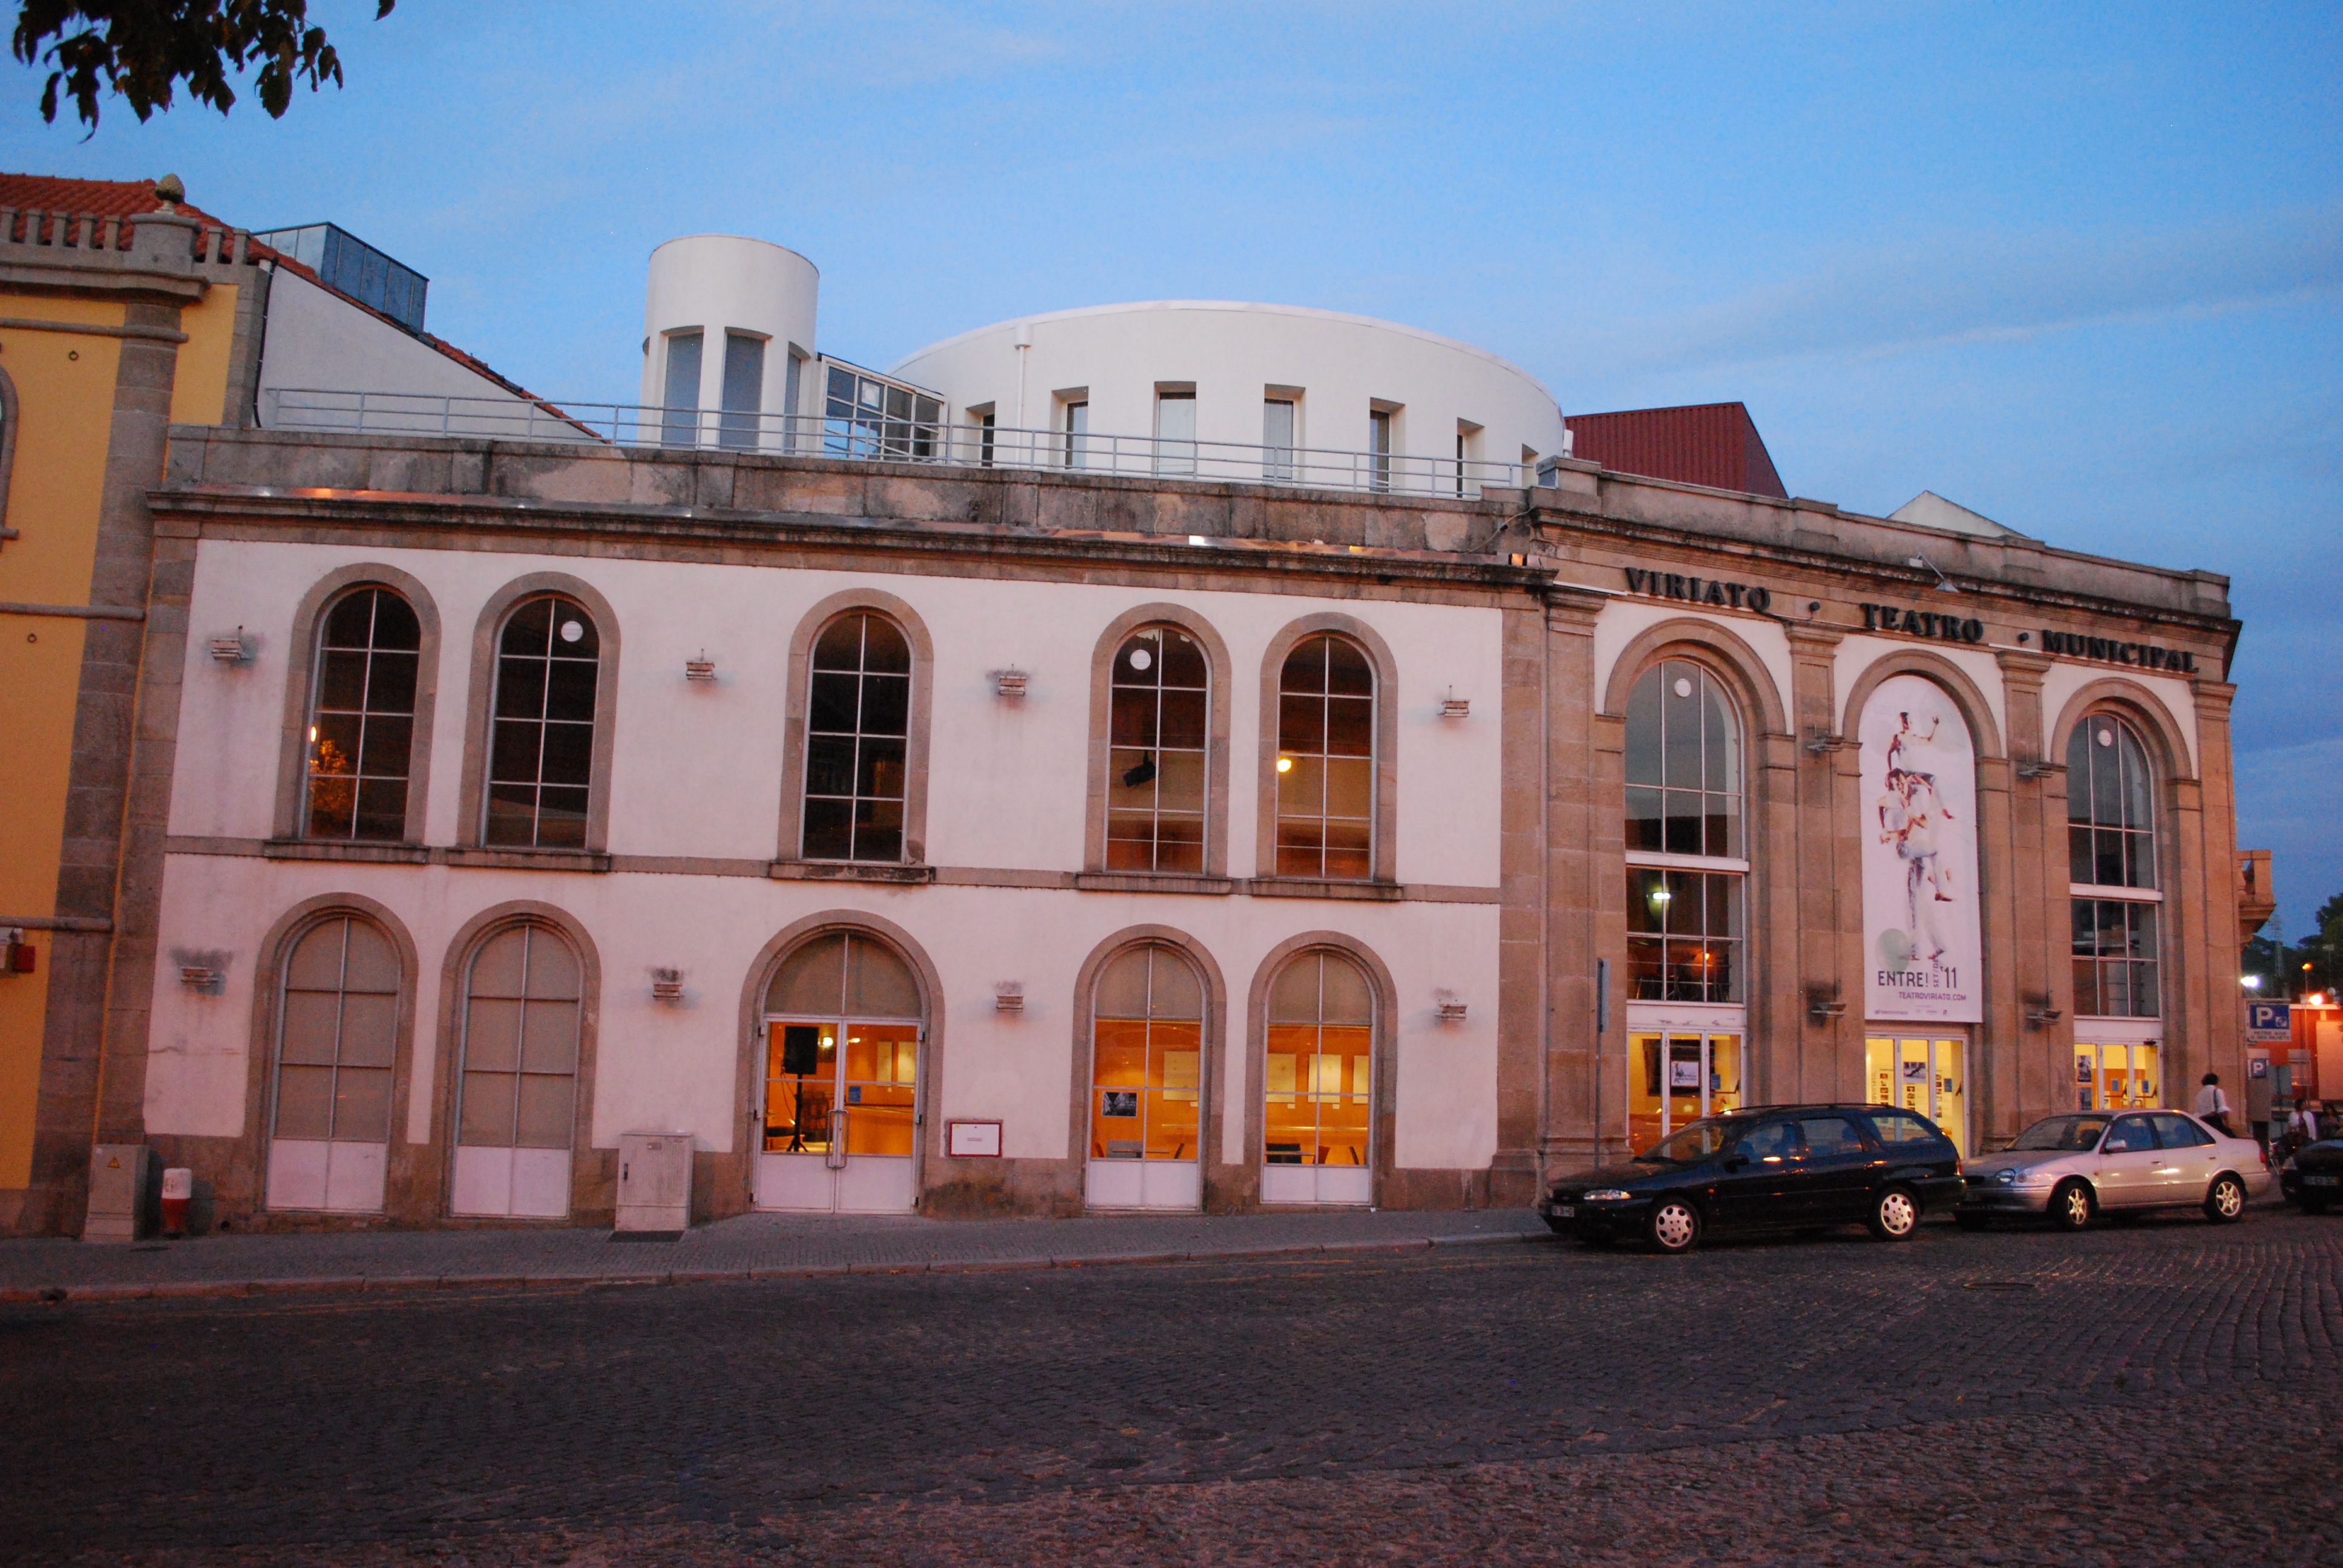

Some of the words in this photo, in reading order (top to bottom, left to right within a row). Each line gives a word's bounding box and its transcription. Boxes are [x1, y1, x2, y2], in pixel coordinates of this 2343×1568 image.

[1625, 567, 1771, 612] VIRIATO
[1860, 603, 1984, 642] TEATRO
[2042, 629, 2199, 673] MUNICIPAL
[1878, 970, 1928, 988] ENTRE!
[1898, 991, 1967, 1001] TEATROVIRIATO.COM
[2256, 1007, 2273, 1027] P
[2253, 1062, 2263, 1074] P
